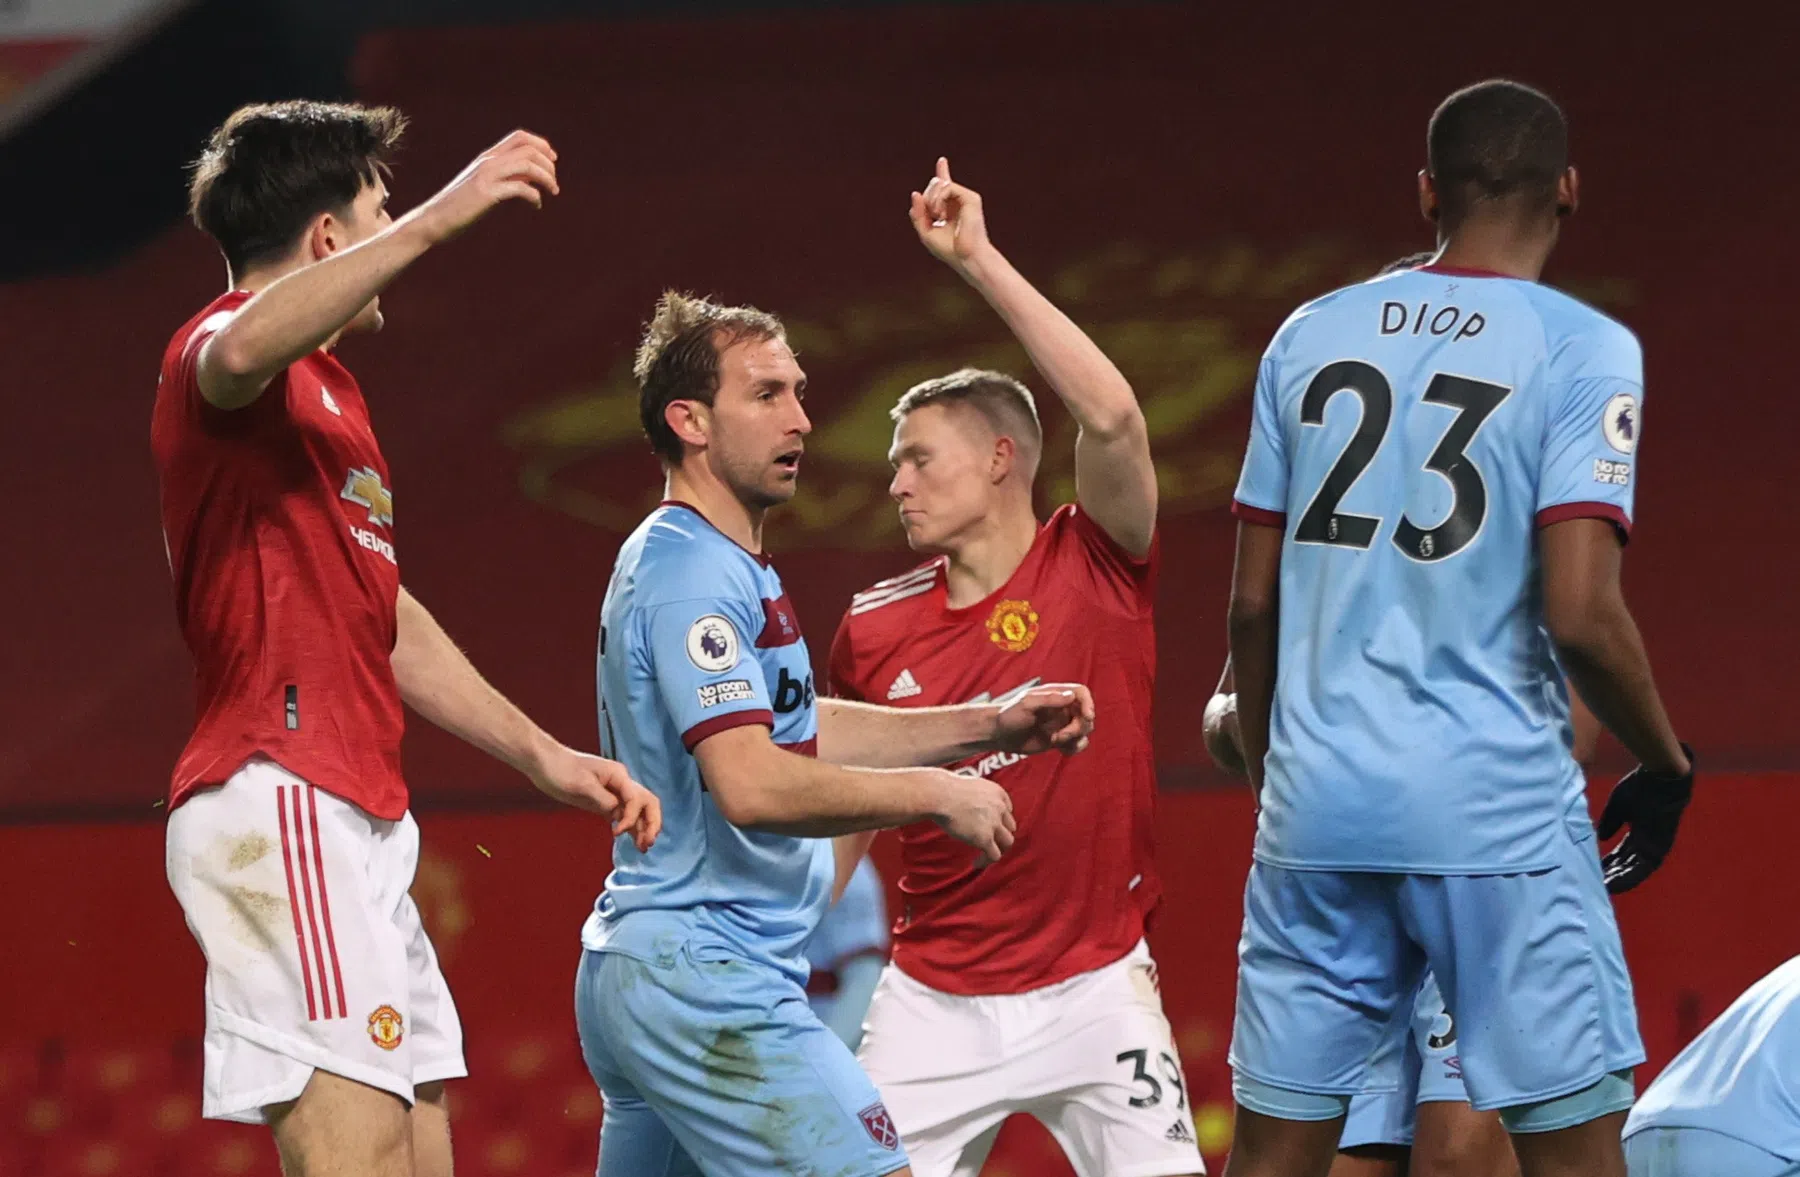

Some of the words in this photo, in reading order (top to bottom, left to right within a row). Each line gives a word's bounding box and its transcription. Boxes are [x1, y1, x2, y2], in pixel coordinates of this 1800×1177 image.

[1379, 300, 1486, 343] DIOP
[1294, 358, 1514, 564] 23
[697, 685, 717, 699] No
[717, 681, 749, 694] room
[700, 695, 718, 709] for
[719, 690, 756, 703] racism
[1116, 1047, 1184, 1111] 39
